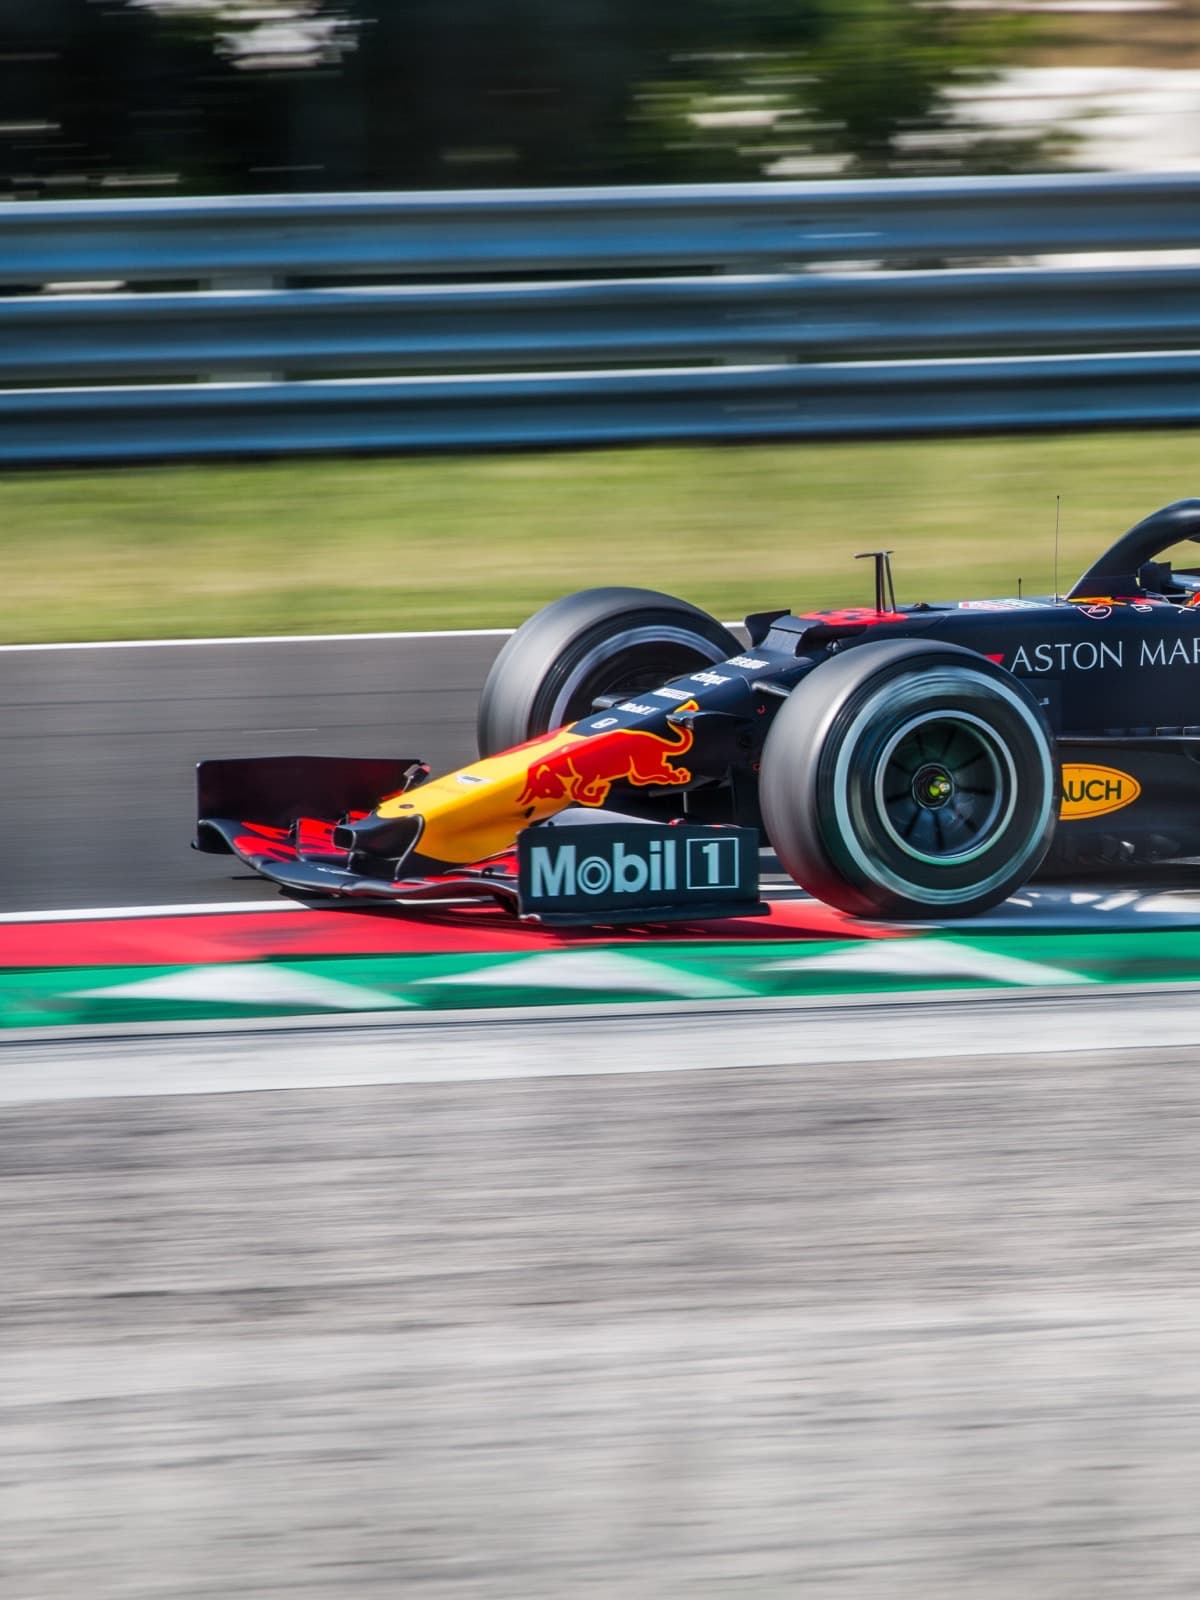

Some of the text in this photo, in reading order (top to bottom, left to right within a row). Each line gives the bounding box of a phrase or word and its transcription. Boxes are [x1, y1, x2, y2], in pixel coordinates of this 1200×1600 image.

[1010, 640, 1123, 673] ASTON
[531, 840, 720, 897] Mobil 1
